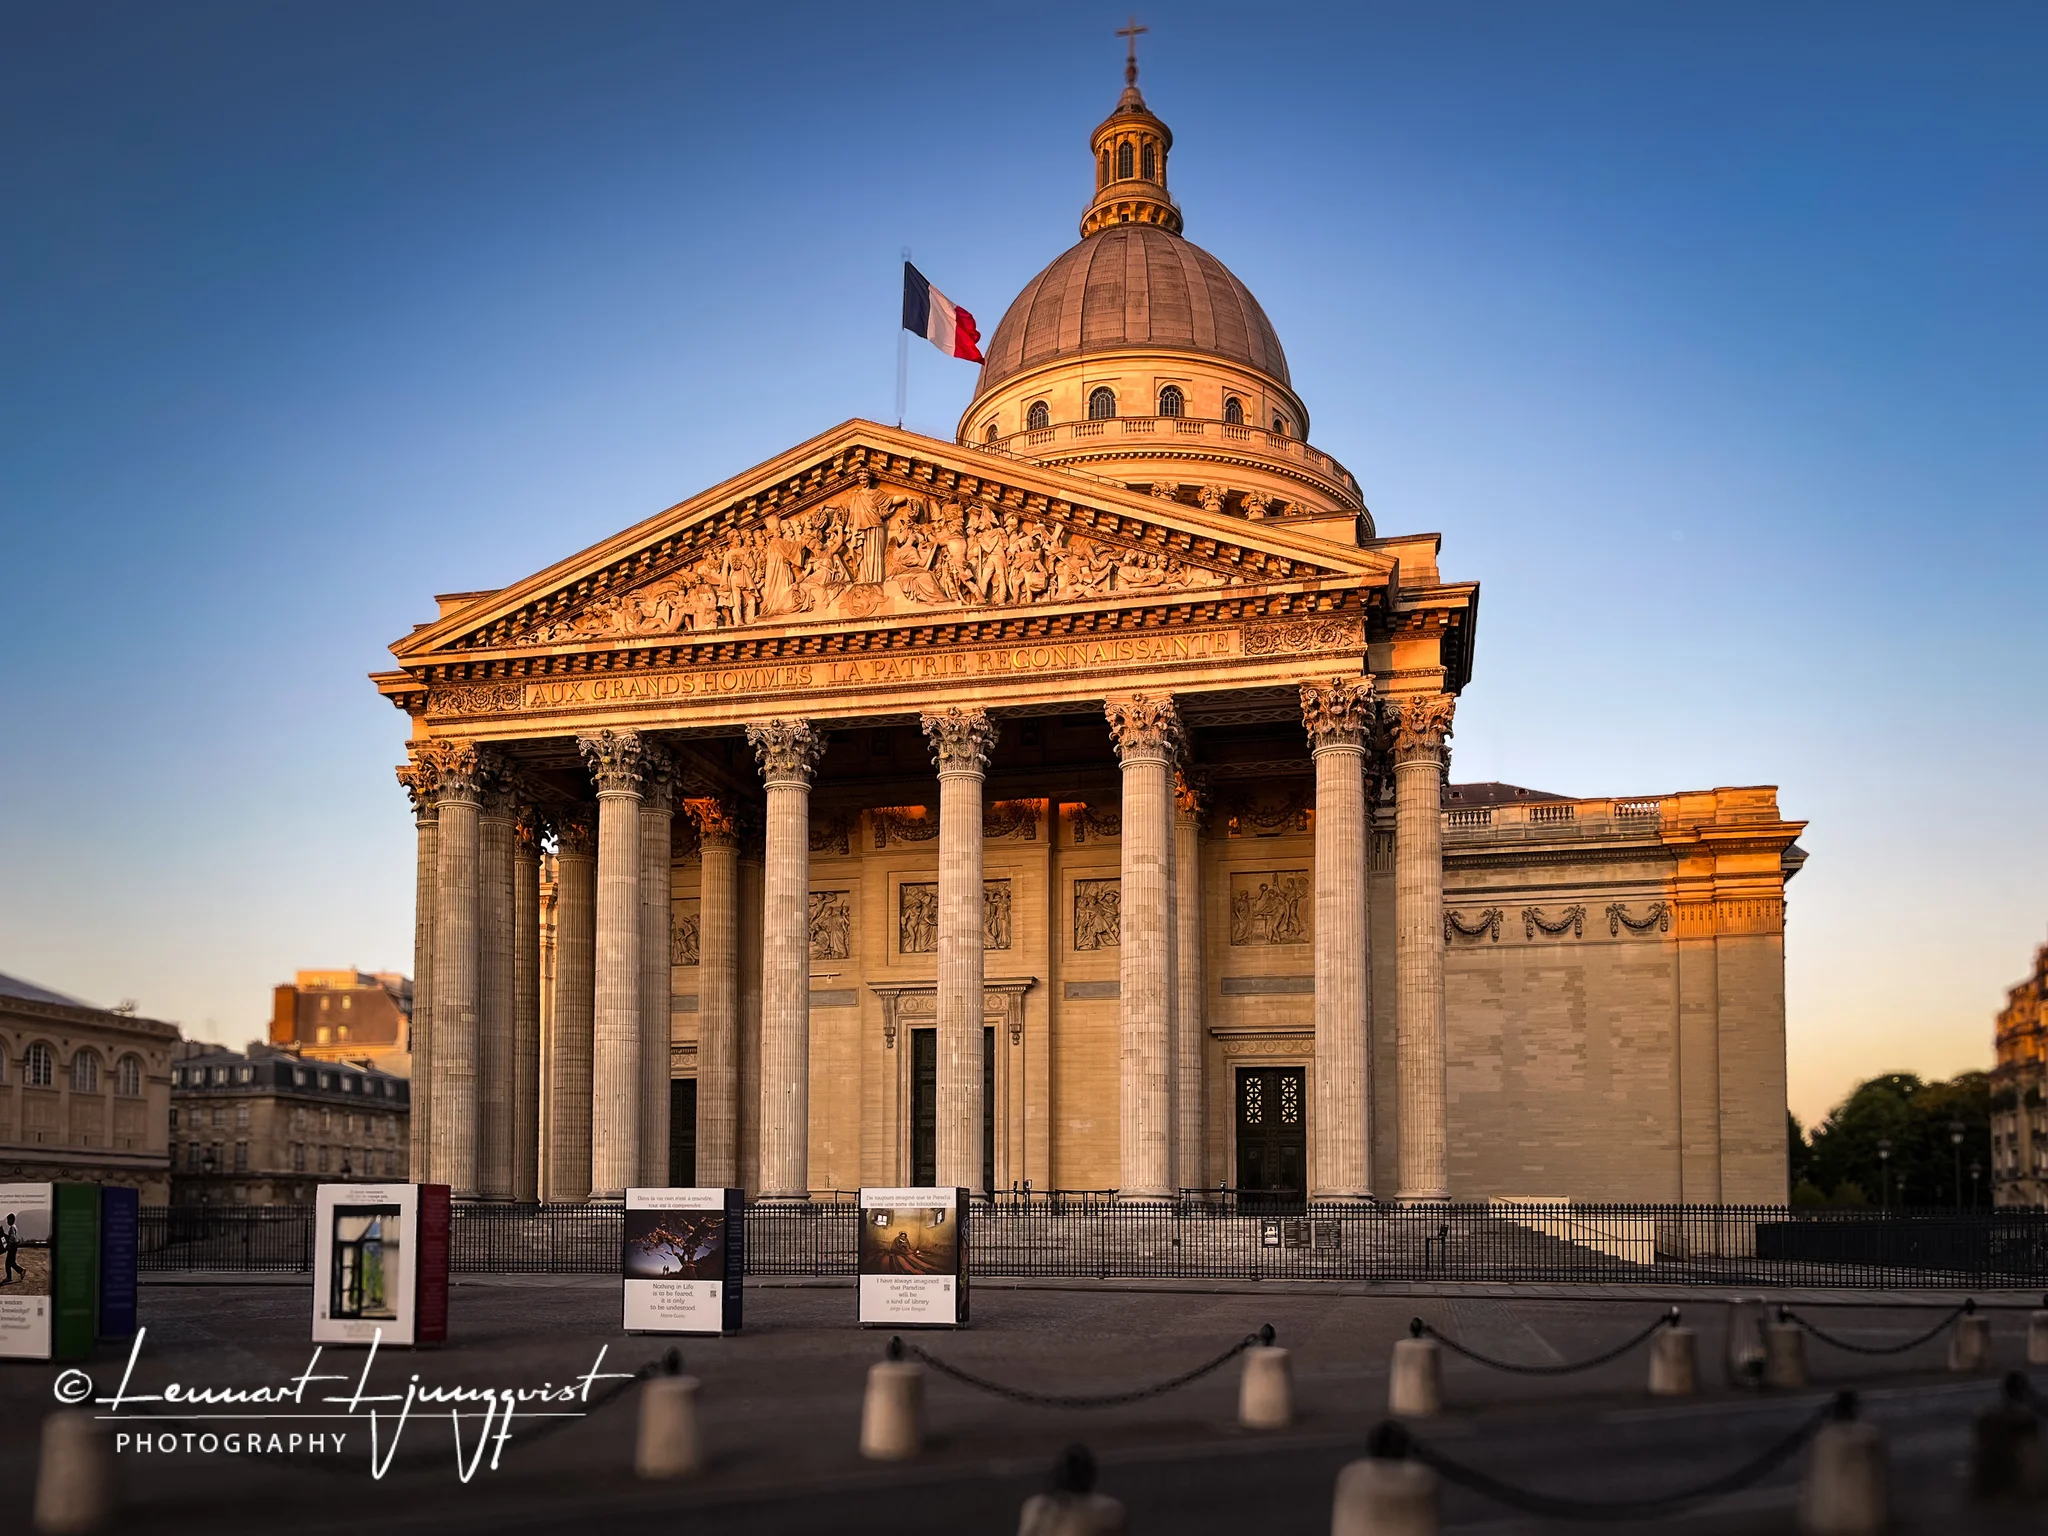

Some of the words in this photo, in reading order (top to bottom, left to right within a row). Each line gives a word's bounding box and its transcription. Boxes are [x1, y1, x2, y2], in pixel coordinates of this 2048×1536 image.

[530, 682, 585, 705] AUX
[590, 674, 696, 700] GRANDS
[700, 665, 813, 692] HOMMES
[827, 662, 863, 684] LA
[870, 654, 968, 680] PATRIE
[976, 631, 1231, 673] RECONNAISSANTE
